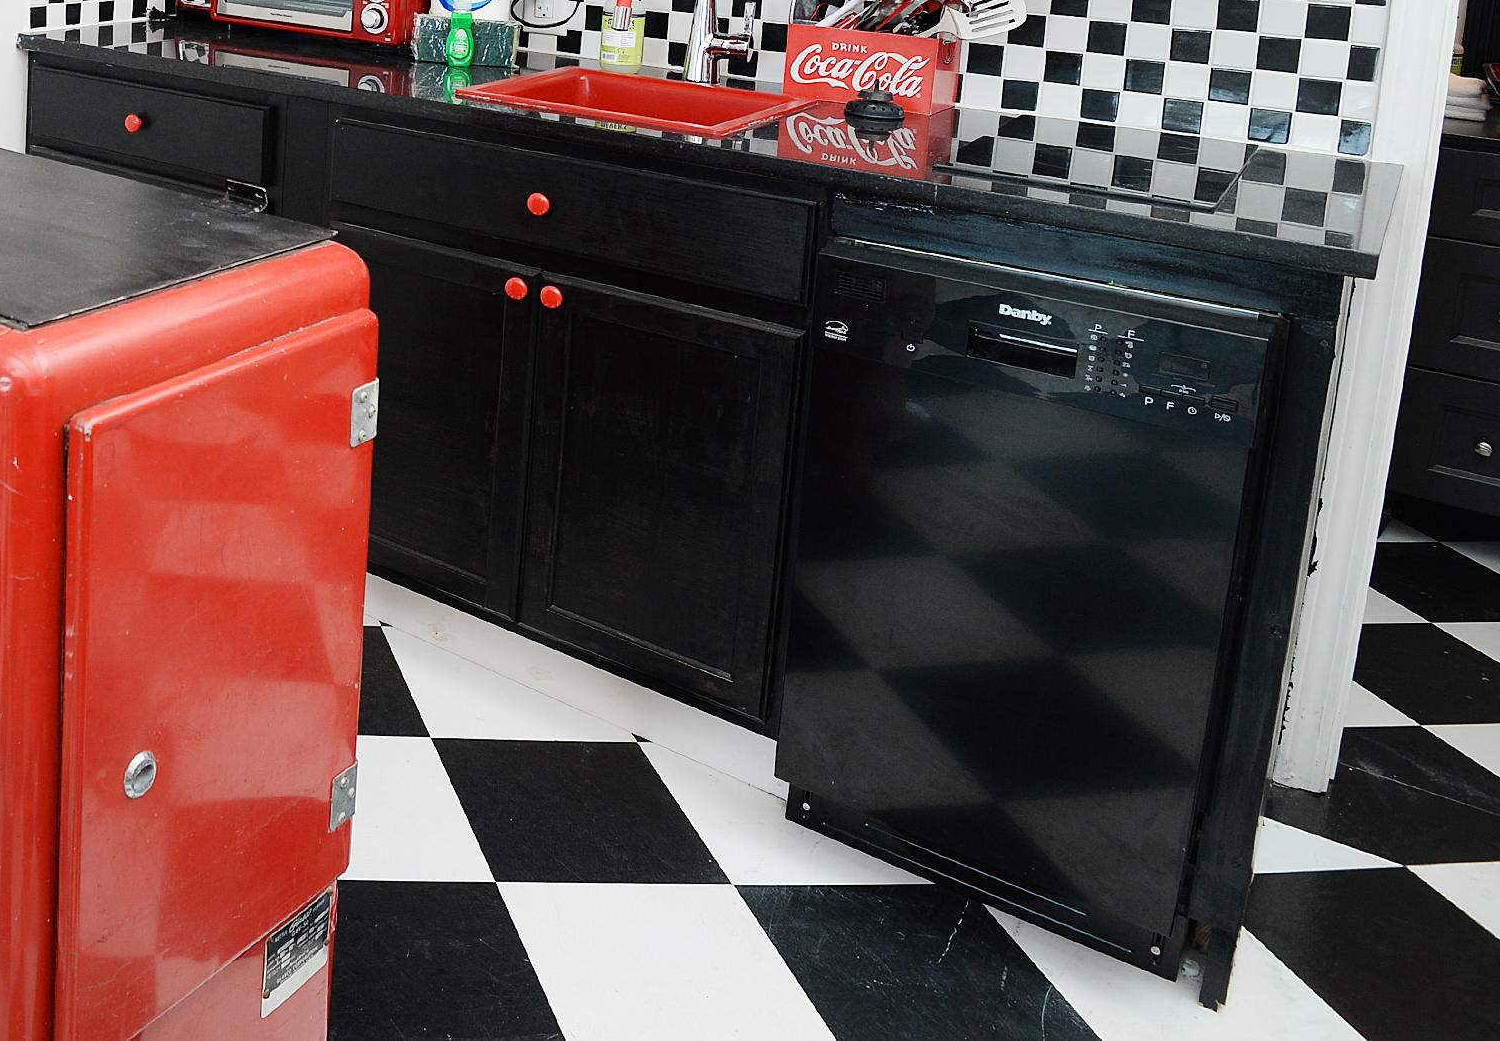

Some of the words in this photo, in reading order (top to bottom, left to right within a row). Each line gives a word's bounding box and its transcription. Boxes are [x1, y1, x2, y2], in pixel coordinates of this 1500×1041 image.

[831, 42, 868, 54] DRINK
[790, 43, 930, 98] Coca-Cola
[999, 303, 1052, 326] Danby
[1144, 396, 1154, 405] P
[1166, 402, 1175, 410] F
